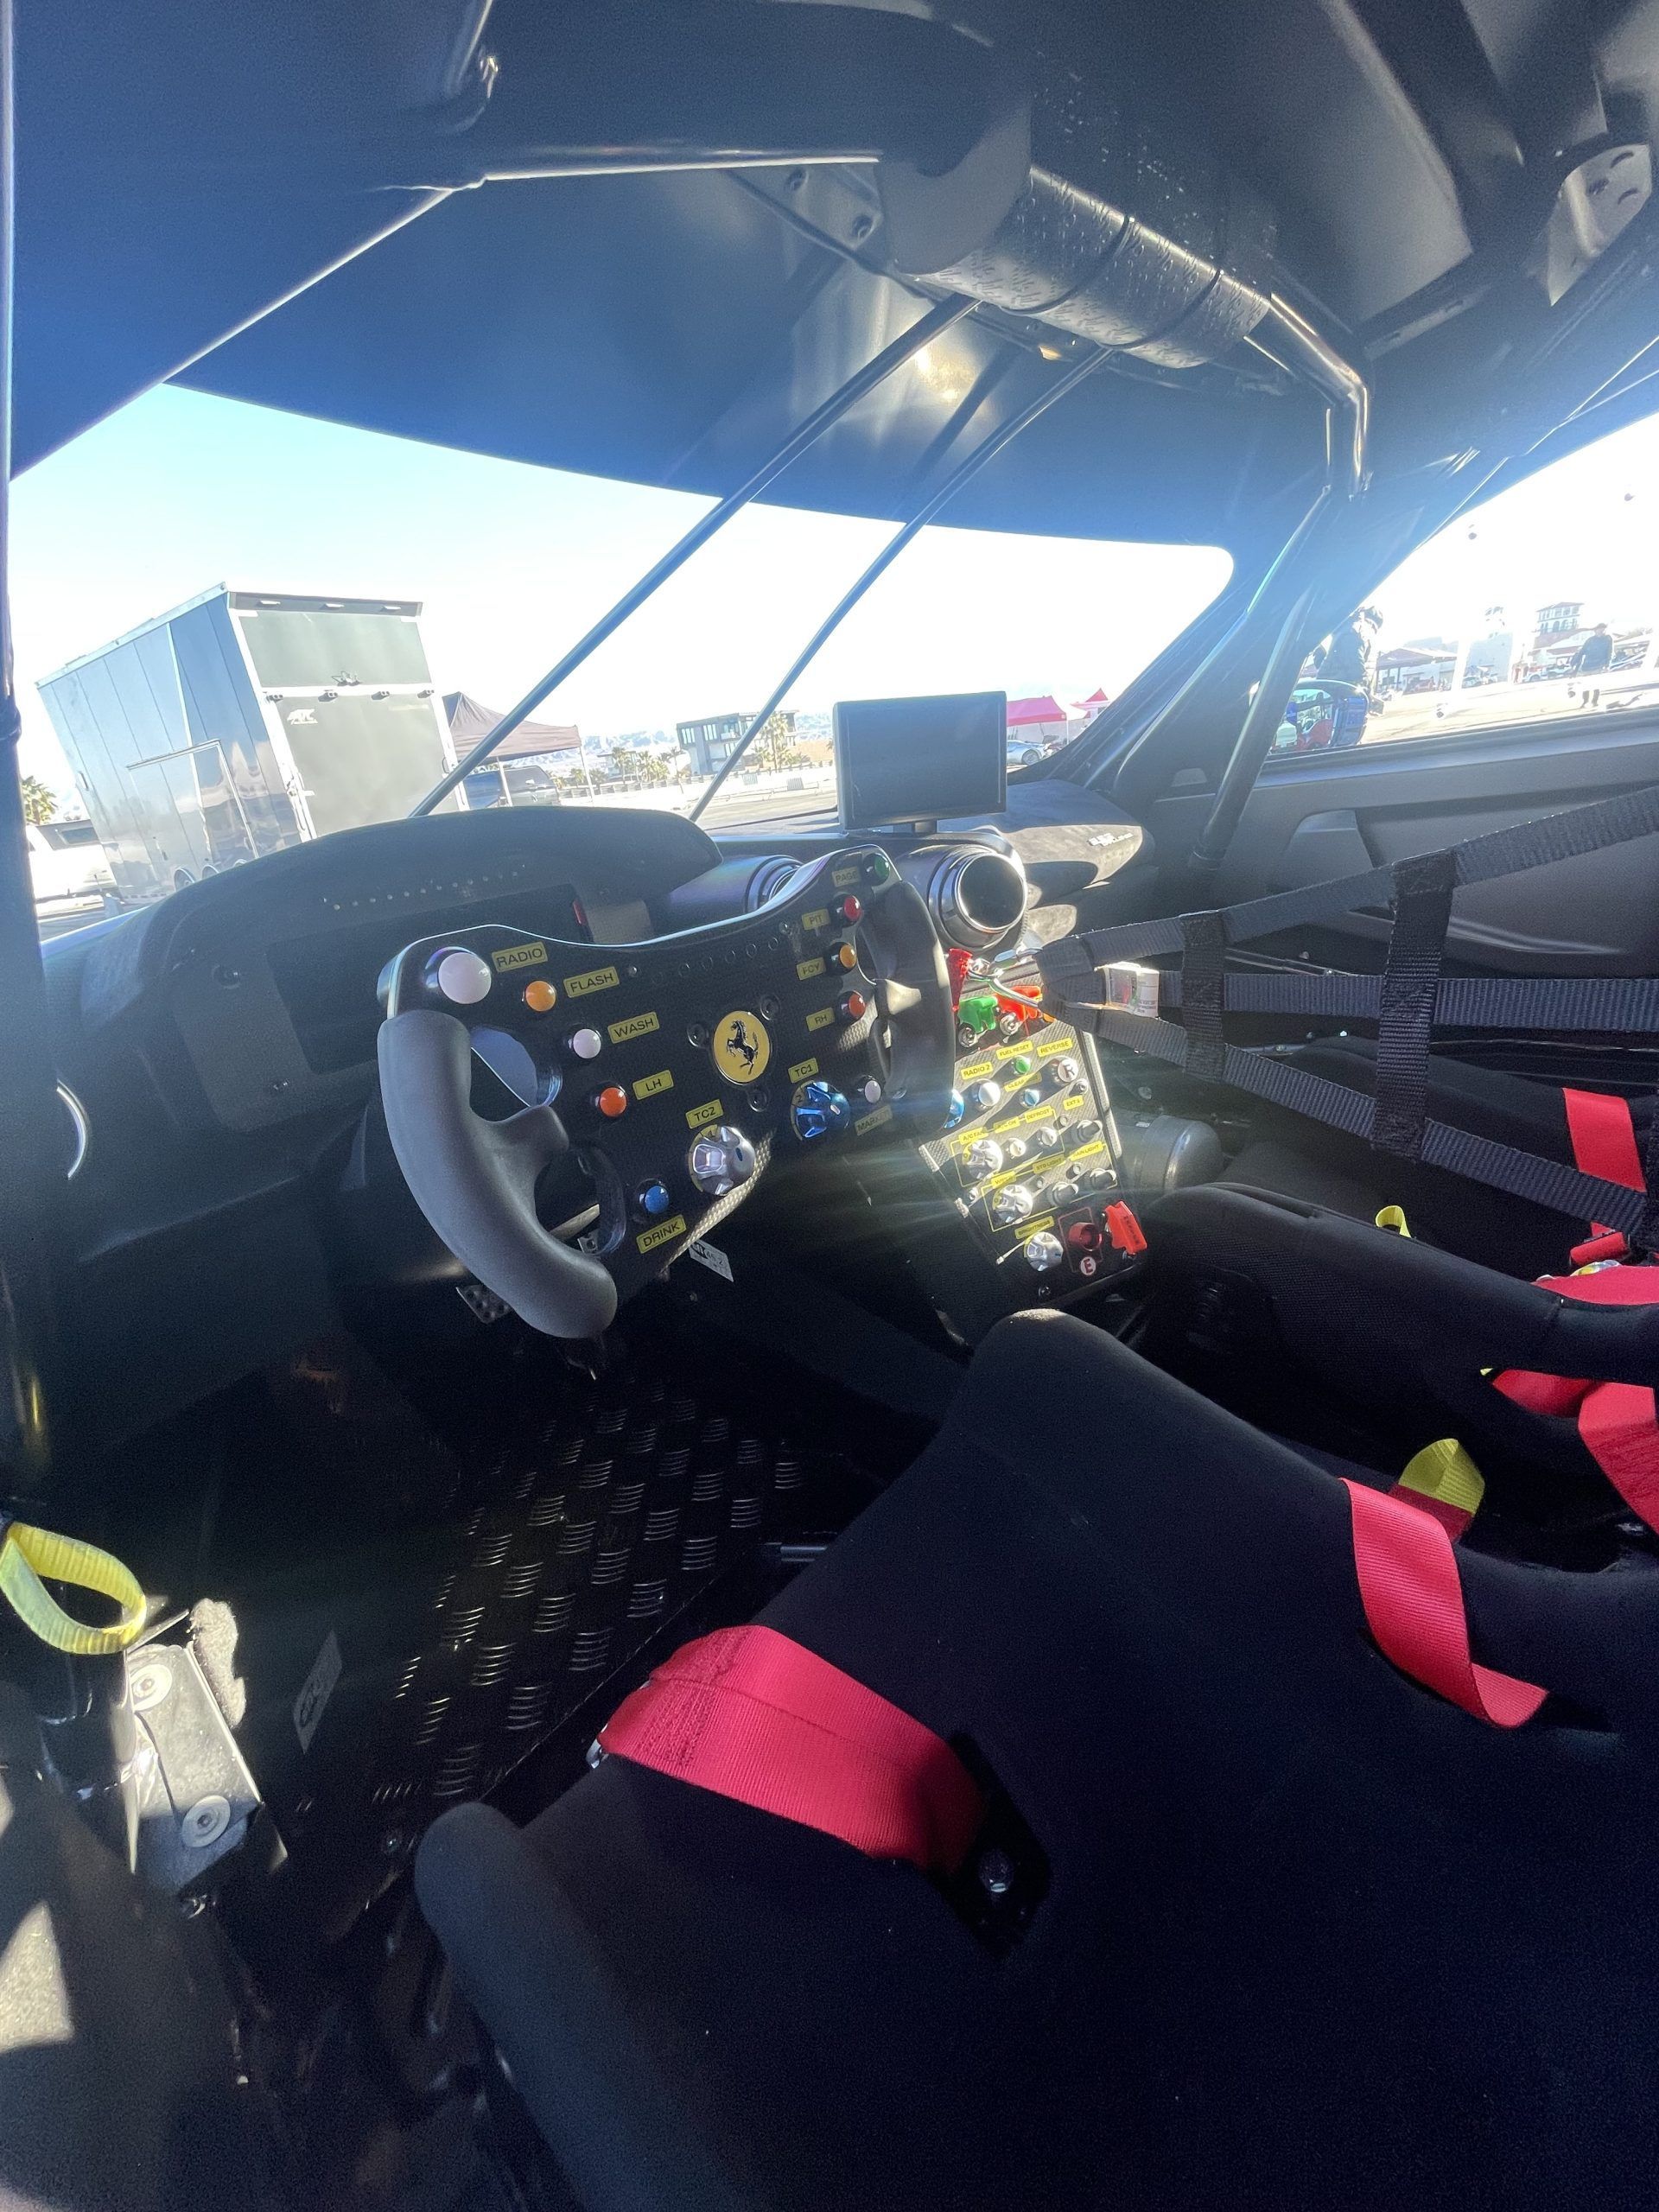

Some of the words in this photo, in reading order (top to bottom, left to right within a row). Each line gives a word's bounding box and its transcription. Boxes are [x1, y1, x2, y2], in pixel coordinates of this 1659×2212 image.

[835, 870, 858, 883] PAGE
[809, 914, 823, 925] PIT
[496, 947, 543, 968] RADIO
[802, 962, 821, 976] FCY
[569, 972, 615, 993] FLASH
[815, 1013, 829, 1025] RH
[613, 1018, 655, 1038] WASH
[1039, 1040, 1071, 1054] REVERSE
[794, 1065, 813, 1077] TC1
[963, 1065, 985, 1077] RADIO
[1062, 1064, 1076, 1078] R
[645, 1077, 663, 1092] LH
[694, 1106, 716, 1122] TC2
[1026, 1108, 1051, 1120] DEFROST
[963, 1131, 974, 1141] A/C
[1084, 1144, 1100, 1154] LIGHT
[1046, 1157, 1063, 1167] LIGHT
[643, 1220, 681, 1247] DRINK
[1083, 1258, 1094, 1274] E
